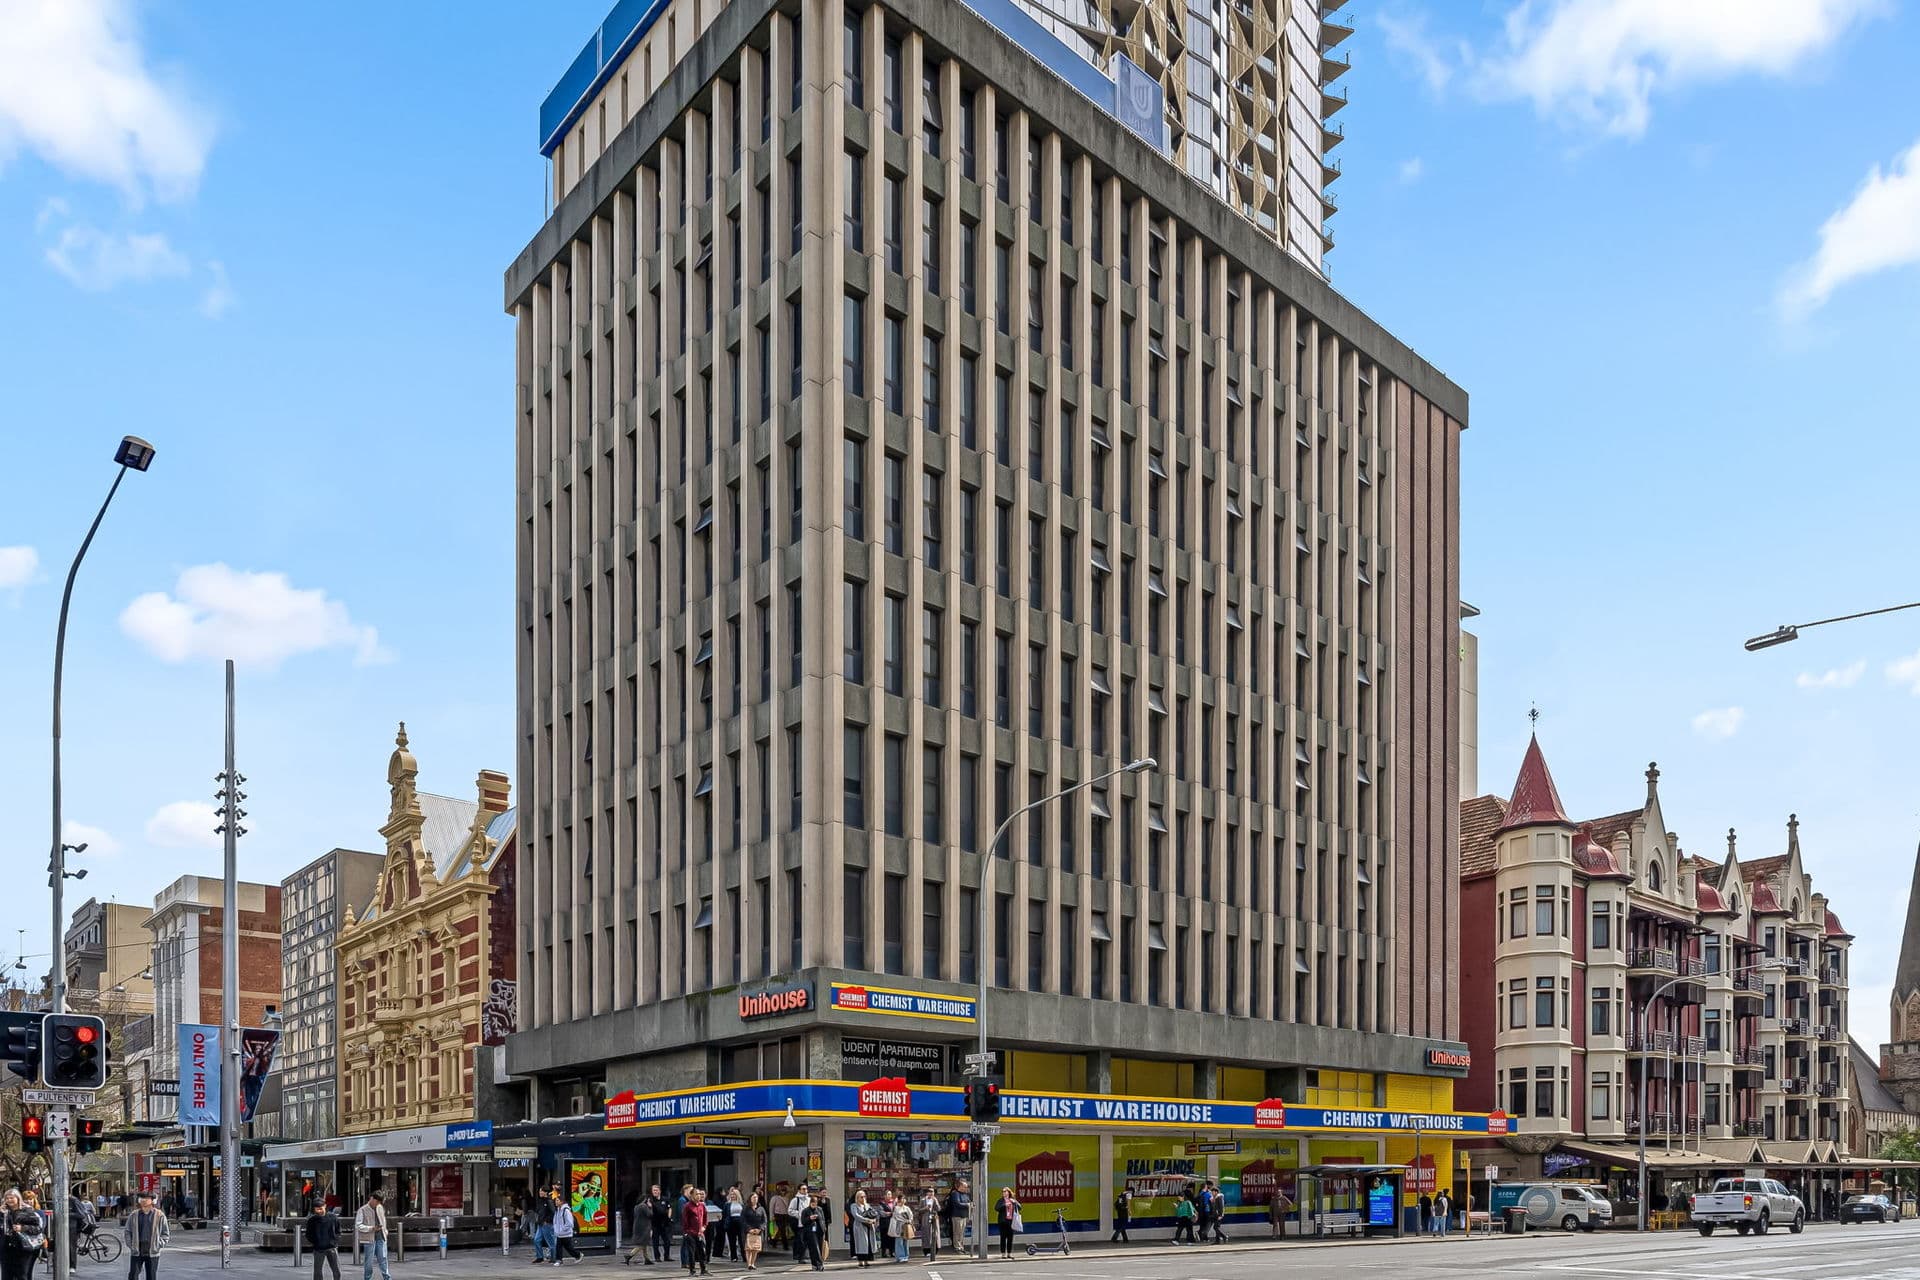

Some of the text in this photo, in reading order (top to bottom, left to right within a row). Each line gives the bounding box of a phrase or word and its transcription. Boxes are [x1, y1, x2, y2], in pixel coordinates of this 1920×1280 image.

[739, 988, 807, 1017] Unihouse
[840, 993, 867, 1002] CHEMIST
[872, 994, 971, 1016] CHEMIST WAREHOUSE
[842, 1042, 939, 1058] UDENT APARTMENTS
[1431, 1050, 1470, 1067] Unihouse
[193, 1033, 206, 1109] ONLY HERE
[38, 1093, 92, 1104] PULTENEY ST
[862, 1090, 908, 1104] CHEMIST
[609, 1103, 635, 1117] CHEMIST
[639, 1092, 736, 1118] CHEMIST WAREHOUSE
[862, 1104, 906, 1113] WAREHOUSE
[1001, 1097, 1212, 1122] HEMIST WAREHOUSE
[1256, 1109, 1283, 1118] CHEMIST
[1323, 1111, 1383, 1127] CHEMIST
[498, 1159, 519, 1168] OSCAR
[1127, 1160, 1150, 1175] REAL
[1019, 1170, 1072, 1187] CHEMIST
[1243, 1174, 1276, 1185] CHEMIST
[1019, 1188, 1070, 1198] WAREHOUSE
[1153, 1180, 1187, 1195] SAVING
